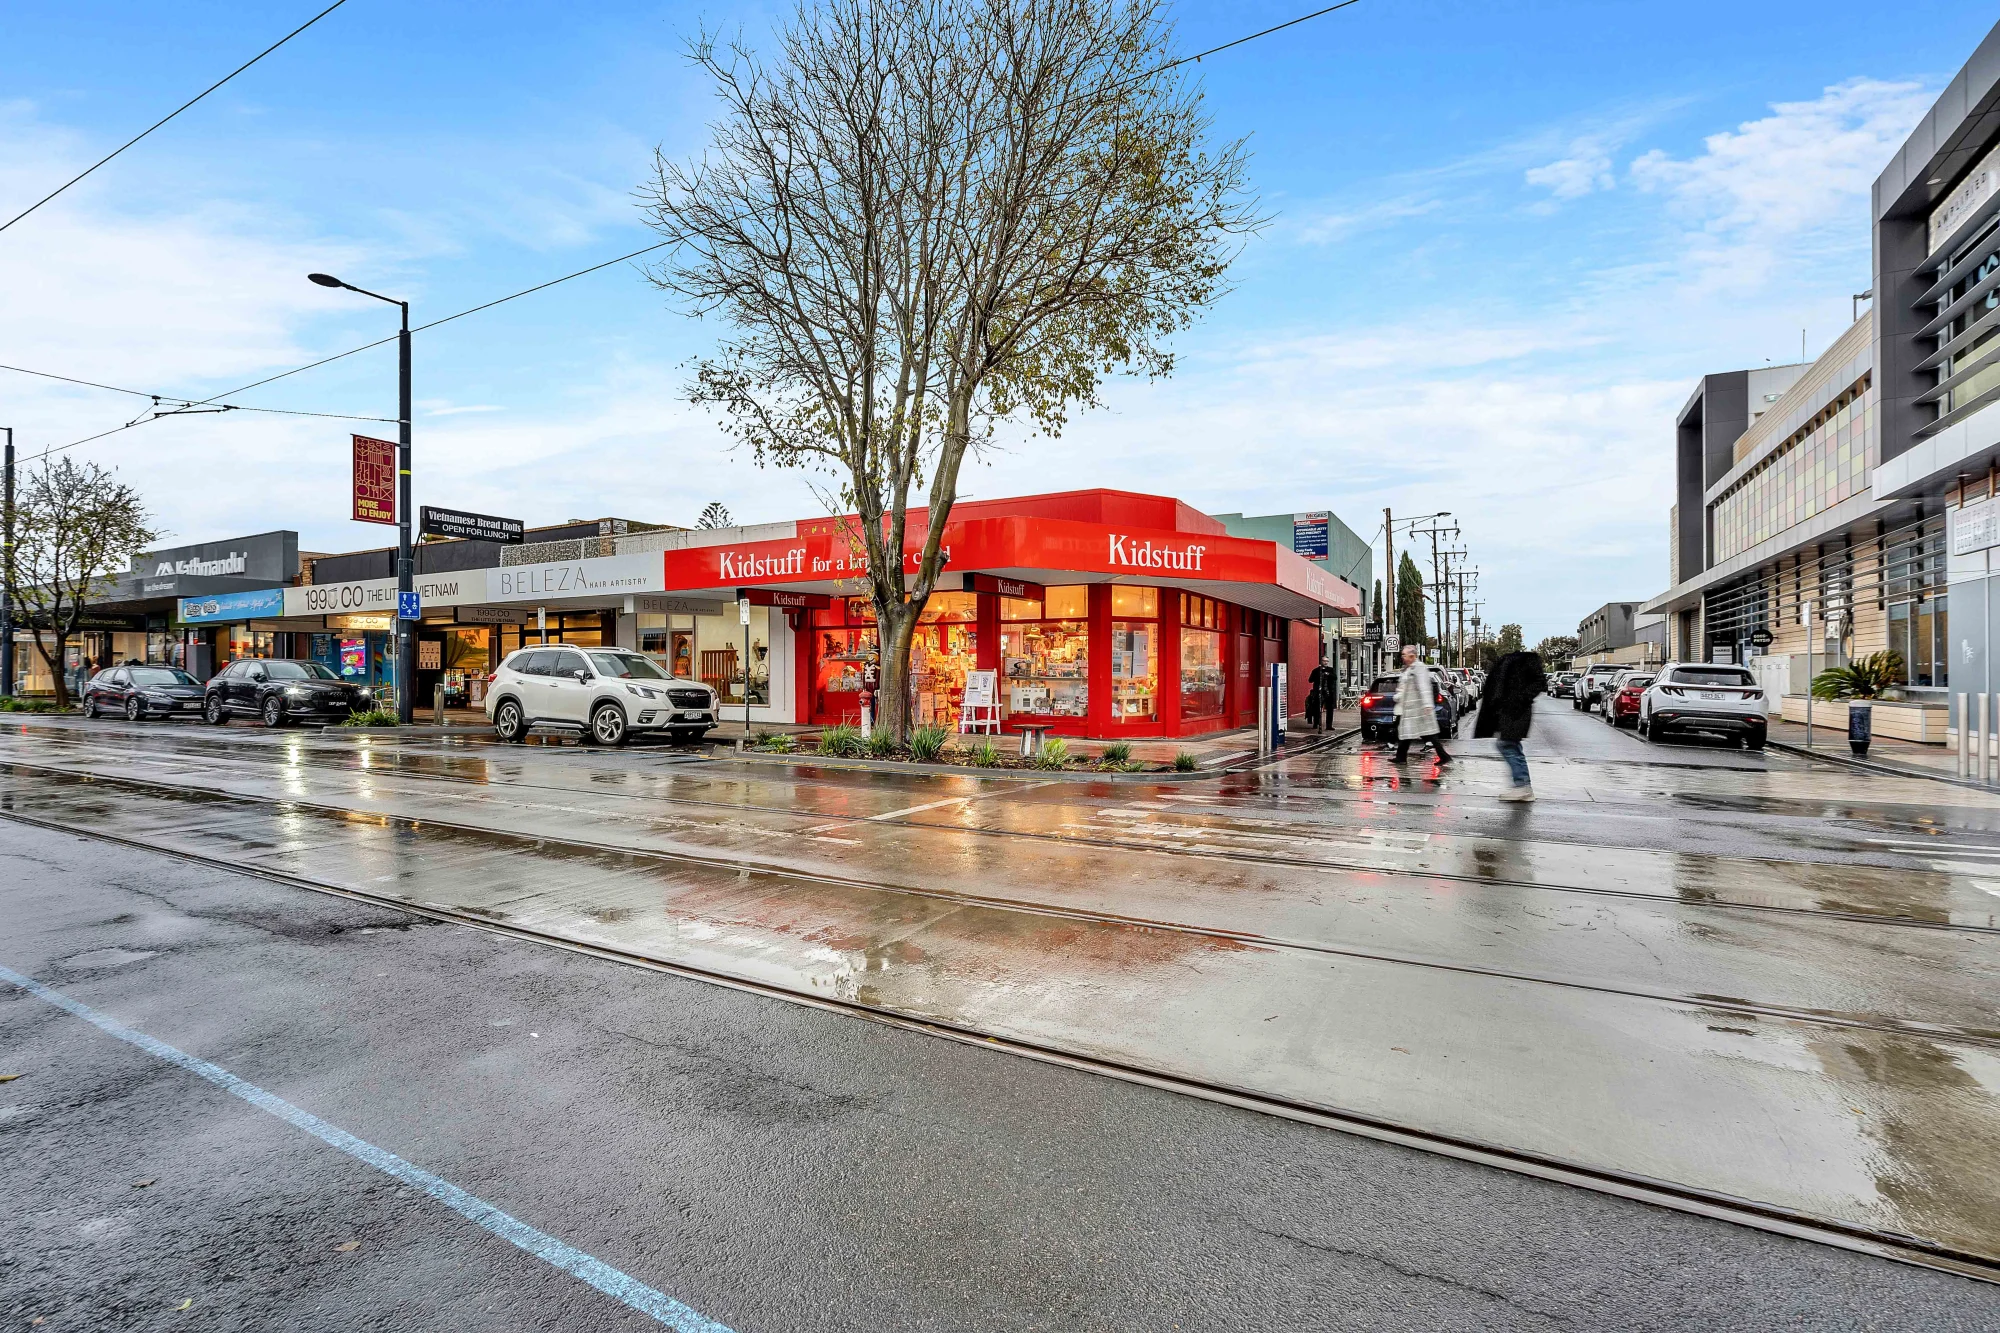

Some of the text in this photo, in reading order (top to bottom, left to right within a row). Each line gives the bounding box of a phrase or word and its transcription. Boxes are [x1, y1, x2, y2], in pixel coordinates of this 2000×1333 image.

[357, 498, 379, 509] MORE
[357, 507, 392, 520] TO ENJOY
[428, 510, 522, 533] Vietnamese Bread Rolls
[442, 524, 509, 540] OPEN FOR LUNCH
[1107, 533, 1206, 572] Kidstuff
[175, 551, 245, 577] Kathmandu
[719, 548, 806, 580] Kidstuff
[812, 556, 832, 572] for
[836, 559, 845, 570] a
[501, 566, 647, 595] BELEZA HAIR ARTISTRY
[998, 579, 1025, 596] Kidstuff
[341, 585, 364, 609] CO
[367, 588, 383, 602] THE
[415, 582, 459, 598] VIETNAM
[773, 592, 806, 606] Kidstuff
[643, 599, 689, 611] BELEZA
[1366, 625, 1381, 634] rush
